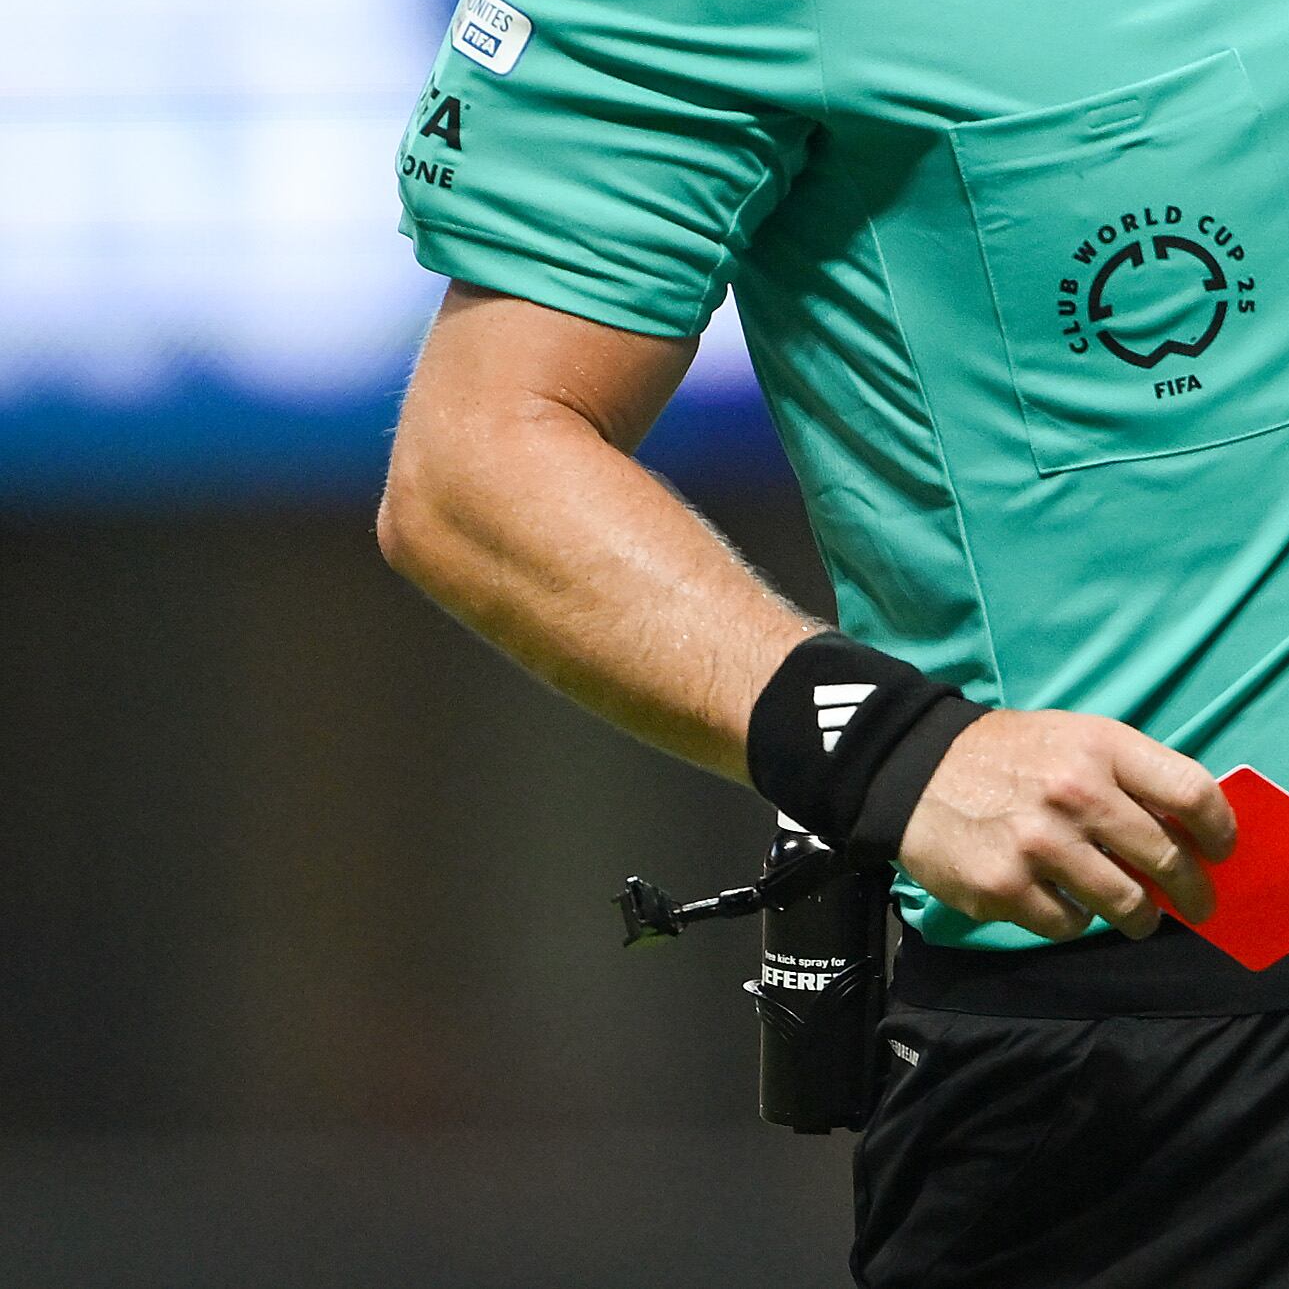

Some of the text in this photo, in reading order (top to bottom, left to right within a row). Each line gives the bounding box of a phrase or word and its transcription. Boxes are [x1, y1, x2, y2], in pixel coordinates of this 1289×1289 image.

[465, 25, 500, 54] FIFA
[1057, 205, 1255, 354] CLUB WORLD CUP 25
[1153, 374, 1202, 399] FIFA
[777, 953, 797, 965] kick
[798, 958, 829, 969] spray
[831, 957, 847, 967] for
[762, 963, 839, 991] EFERE
